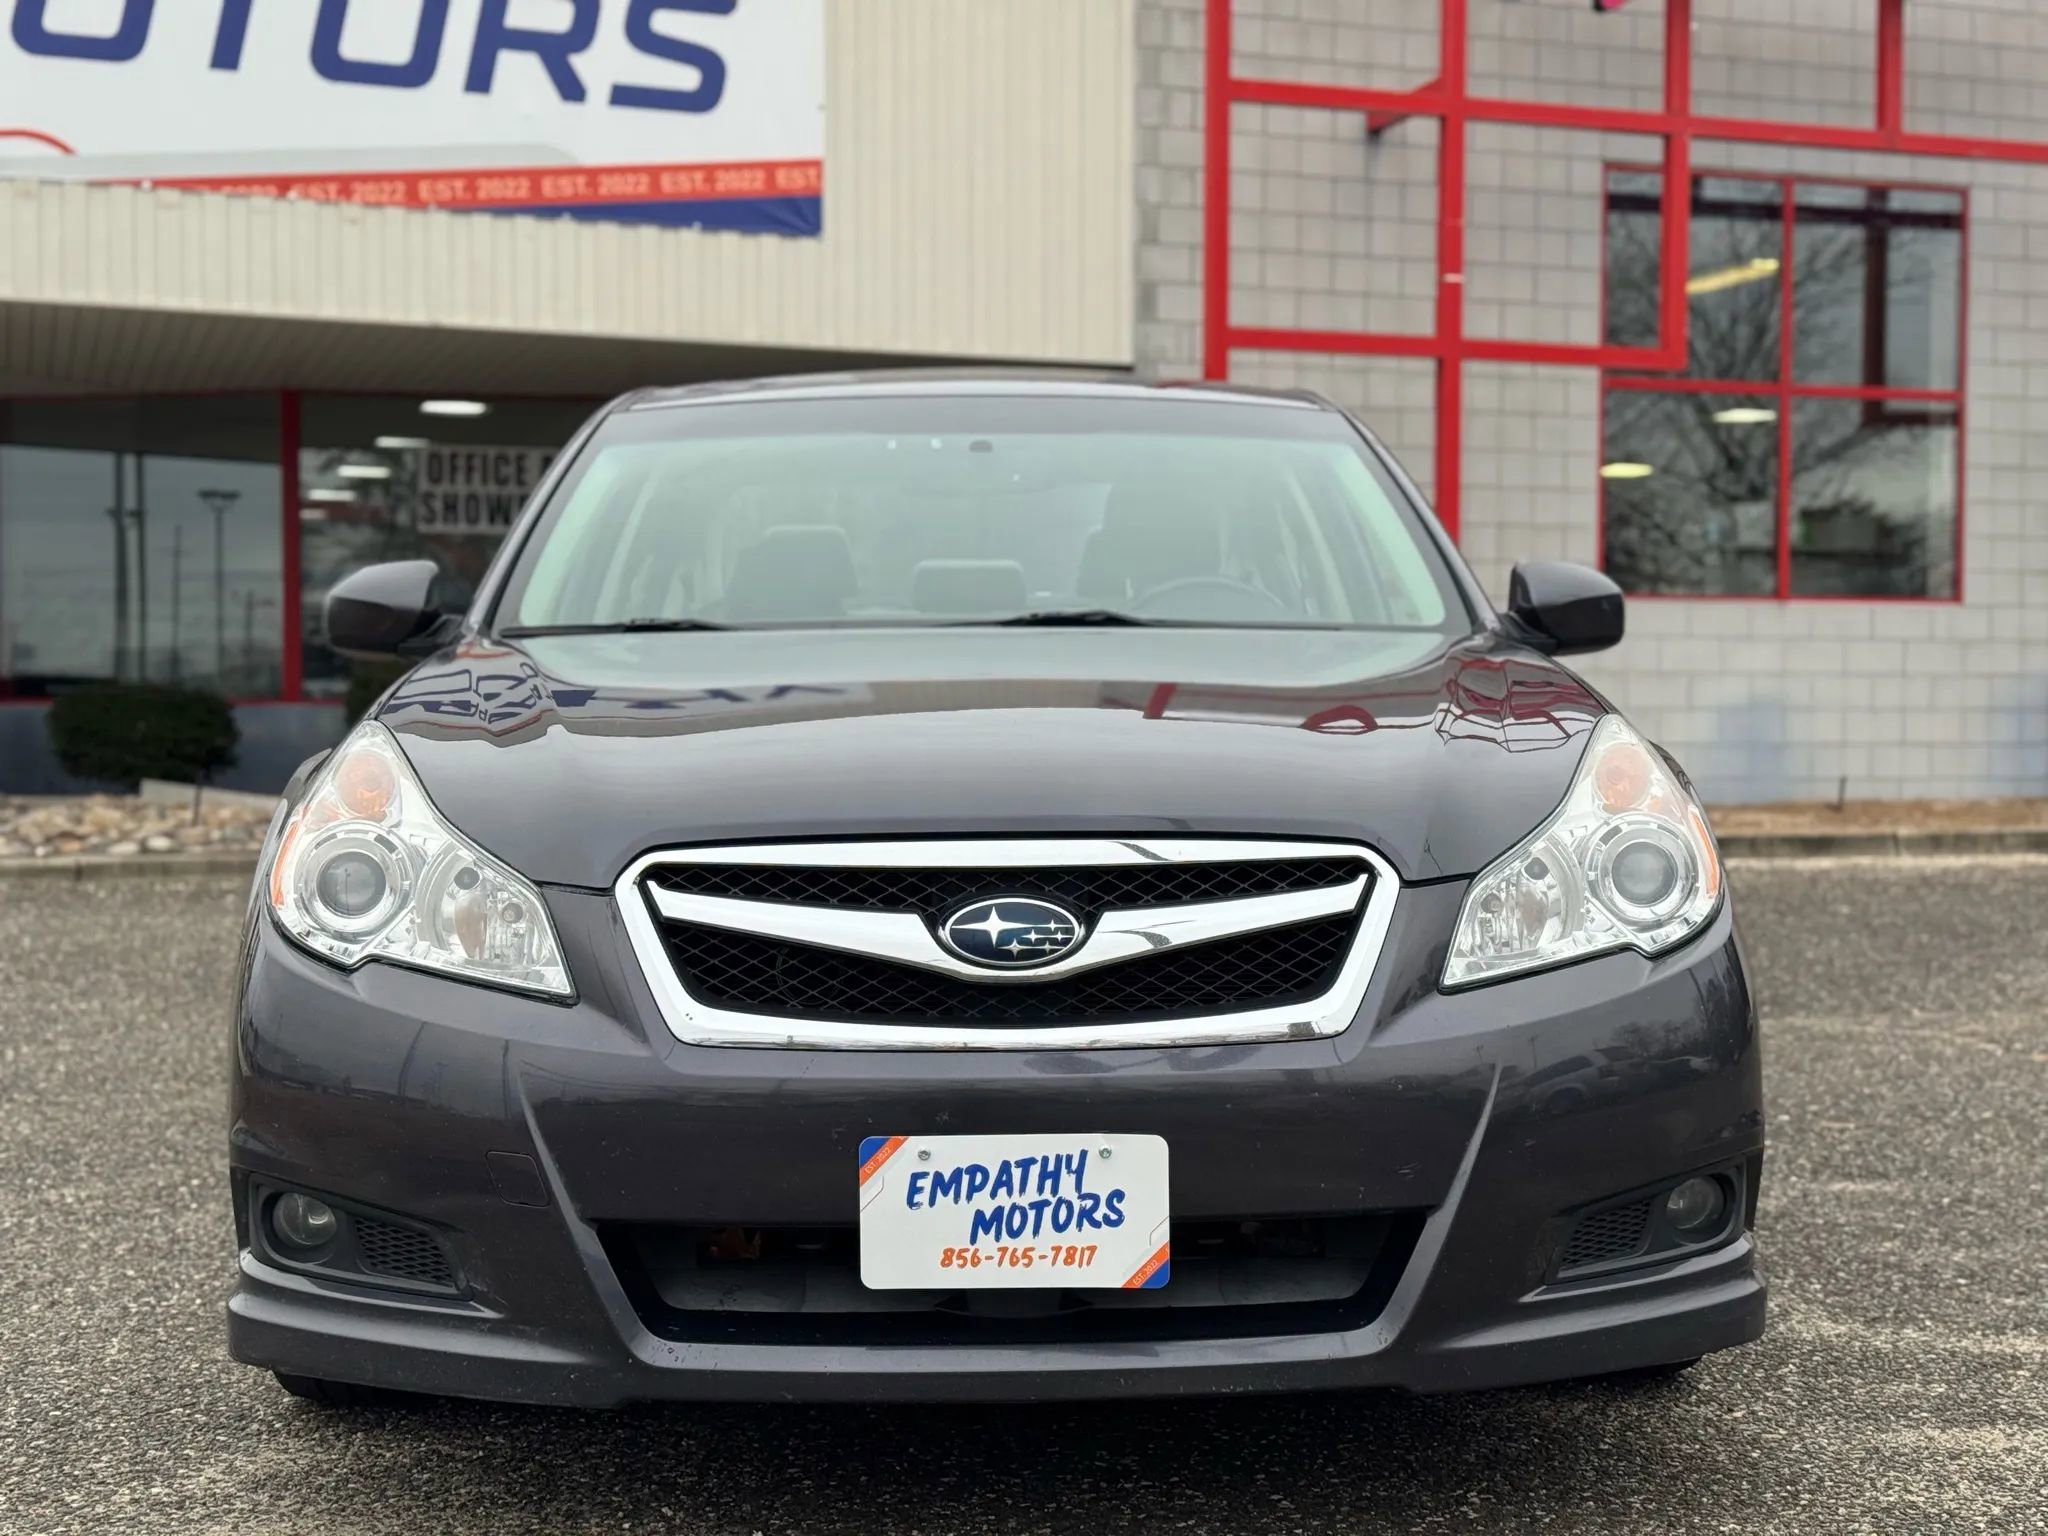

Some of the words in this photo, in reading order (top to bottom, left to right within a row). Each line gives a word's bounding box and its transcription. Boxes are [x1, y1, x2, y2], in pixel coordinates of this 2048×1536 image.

[427, 452, 528, 486] OFFICE
[906, 1149, 1089, 1210] EMPATHY
[969, 1189, 1126, 1246] MOTORS
[940, 1245, 1099, 1269] 856-765-7817
